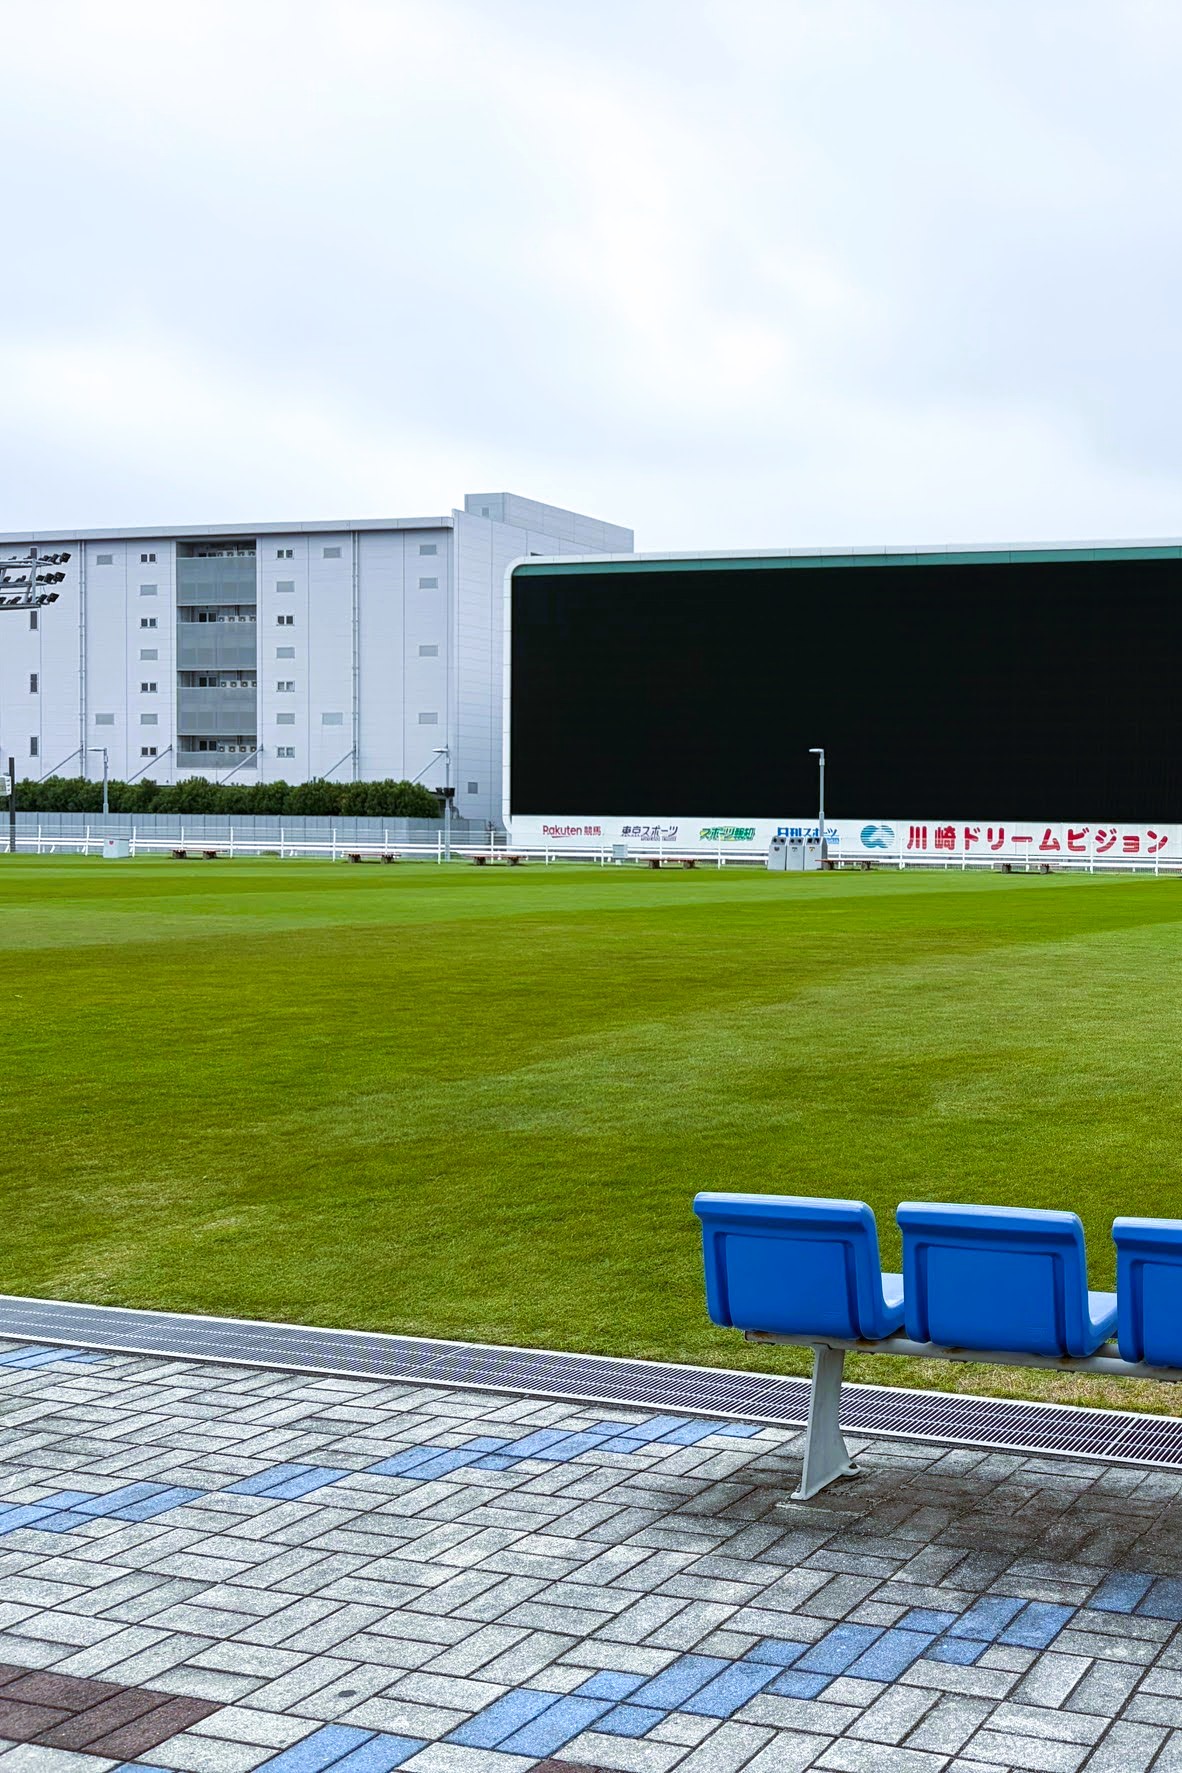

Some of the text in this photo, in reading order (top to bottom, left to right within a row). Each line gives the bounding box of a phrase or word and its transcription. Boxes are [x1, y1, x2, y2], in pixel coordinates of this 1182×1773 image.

[543, 825, 582, 836] Rakuten
[621, 825, 678, 838] 東京スポーツ
[907, 825, 1168, 853] 川崎ドリームビジョン
